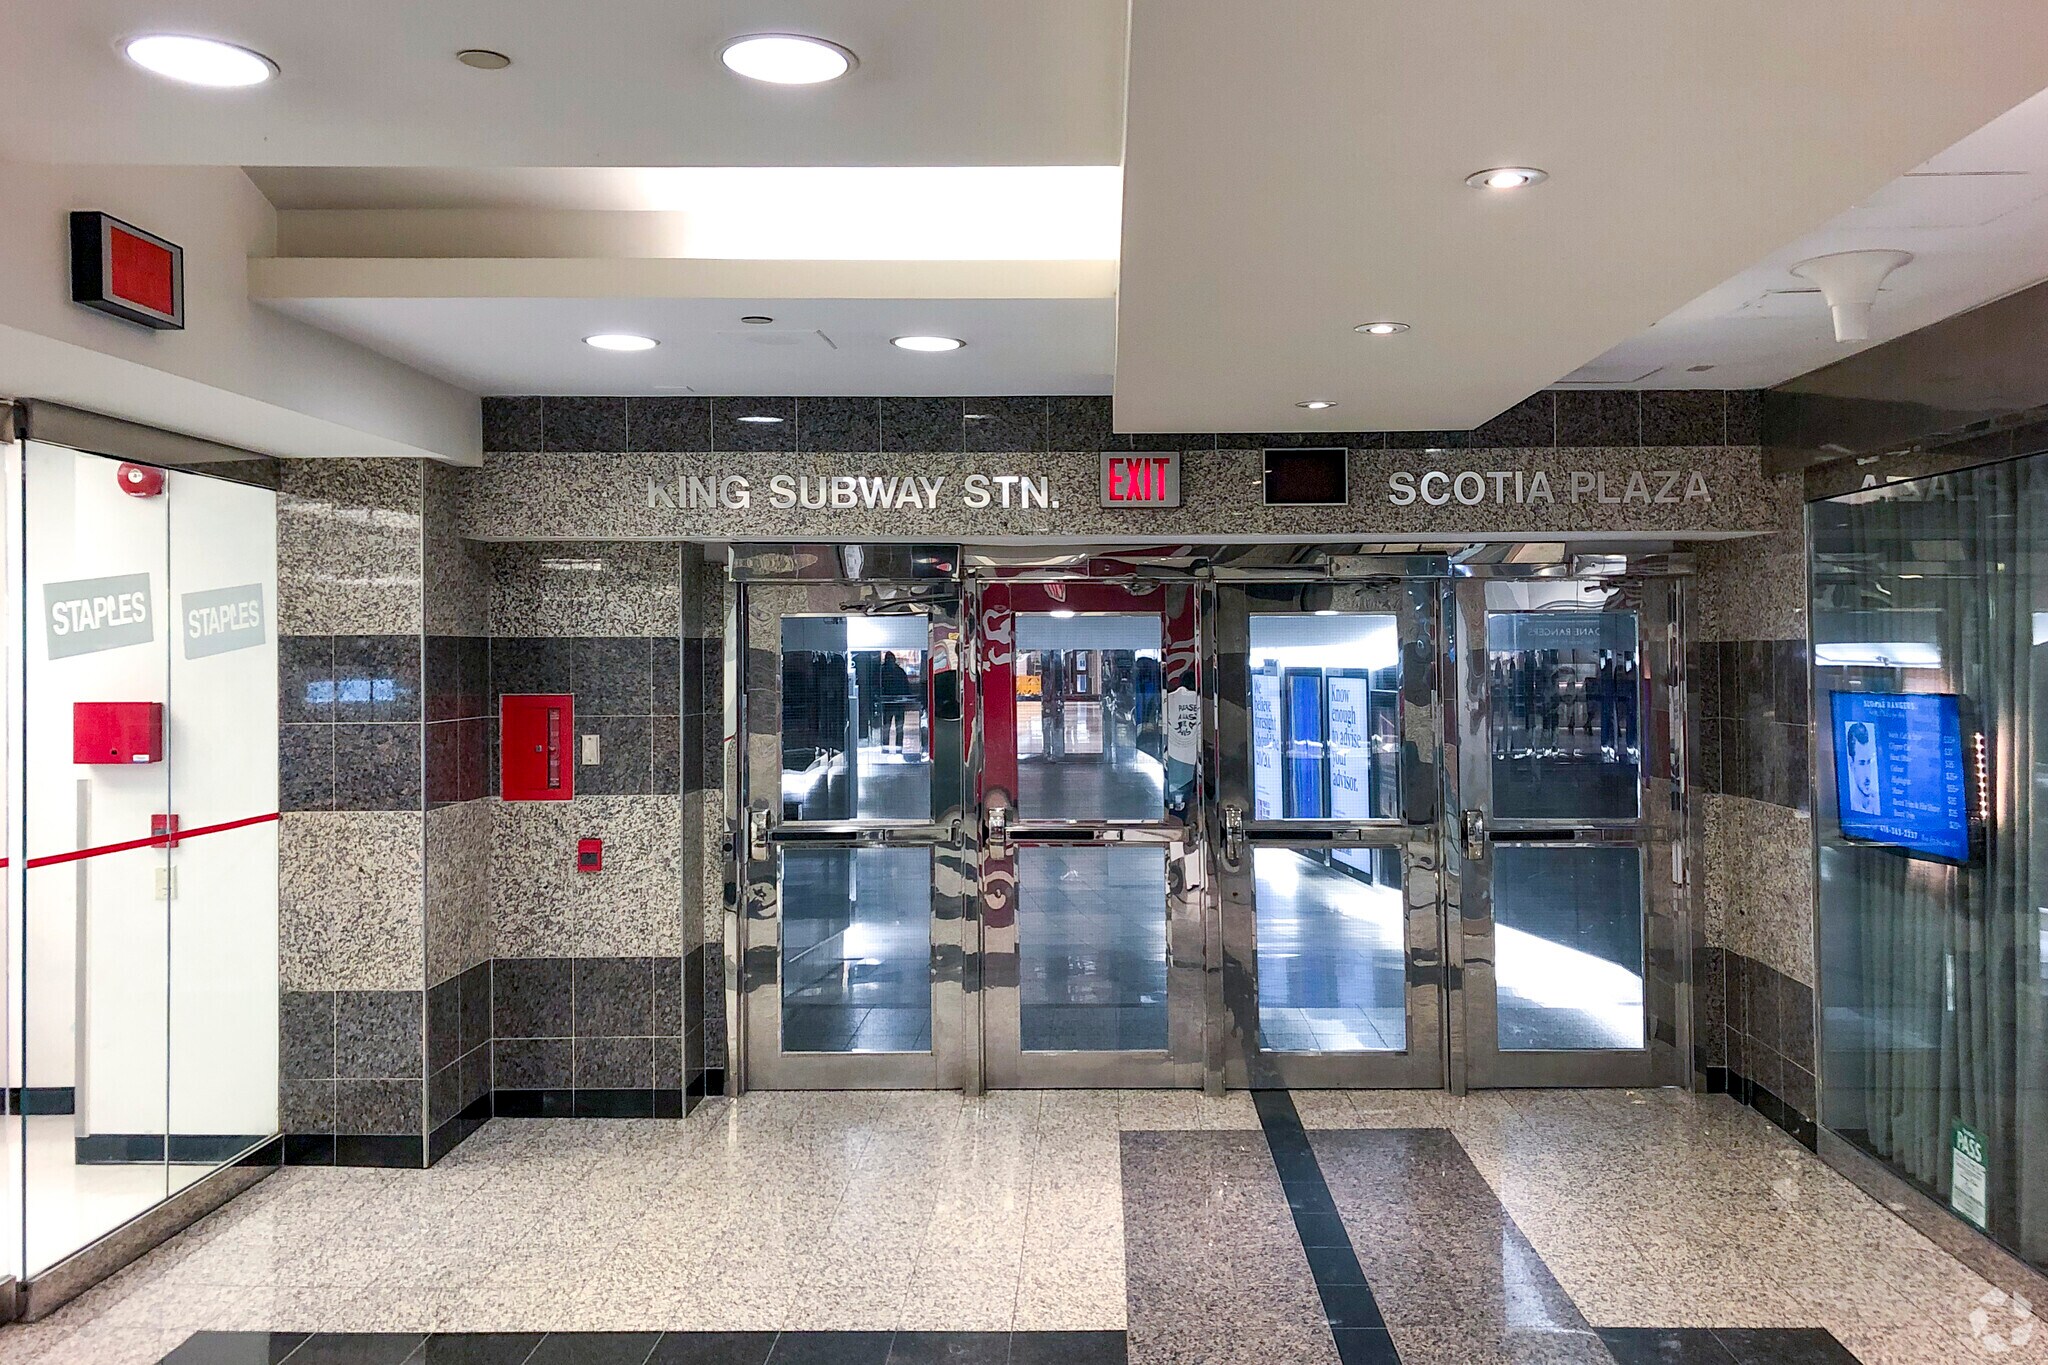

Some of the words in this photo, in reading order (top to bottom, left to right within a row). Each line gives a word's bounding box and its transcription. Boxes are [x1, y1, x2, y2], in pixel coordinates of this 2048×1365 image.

[647, 474, 751, 509] KING
[769, 474, 946, 510] SUBWAY
[963, 474, 1060, 509] STN.
[1108, 457, 1170, 501] EXIT
[1388, 470, 1555, 506] SCOTIA
[1570, 470, 1713, 504] PLAZA
[52, 591, 147, 636] STAPLES
[188, 600, 260, 639] STAPLES
[1331, 684, 1350, 703] Know
[1331, 706, 1356, 728] enough
[1340, 728, 1362, 749] advise
[1332, 749, 1347, 768] your
[1333, 771, 1359, 792] advisor.
[1957, 1130, 1983, 1162] PASS
